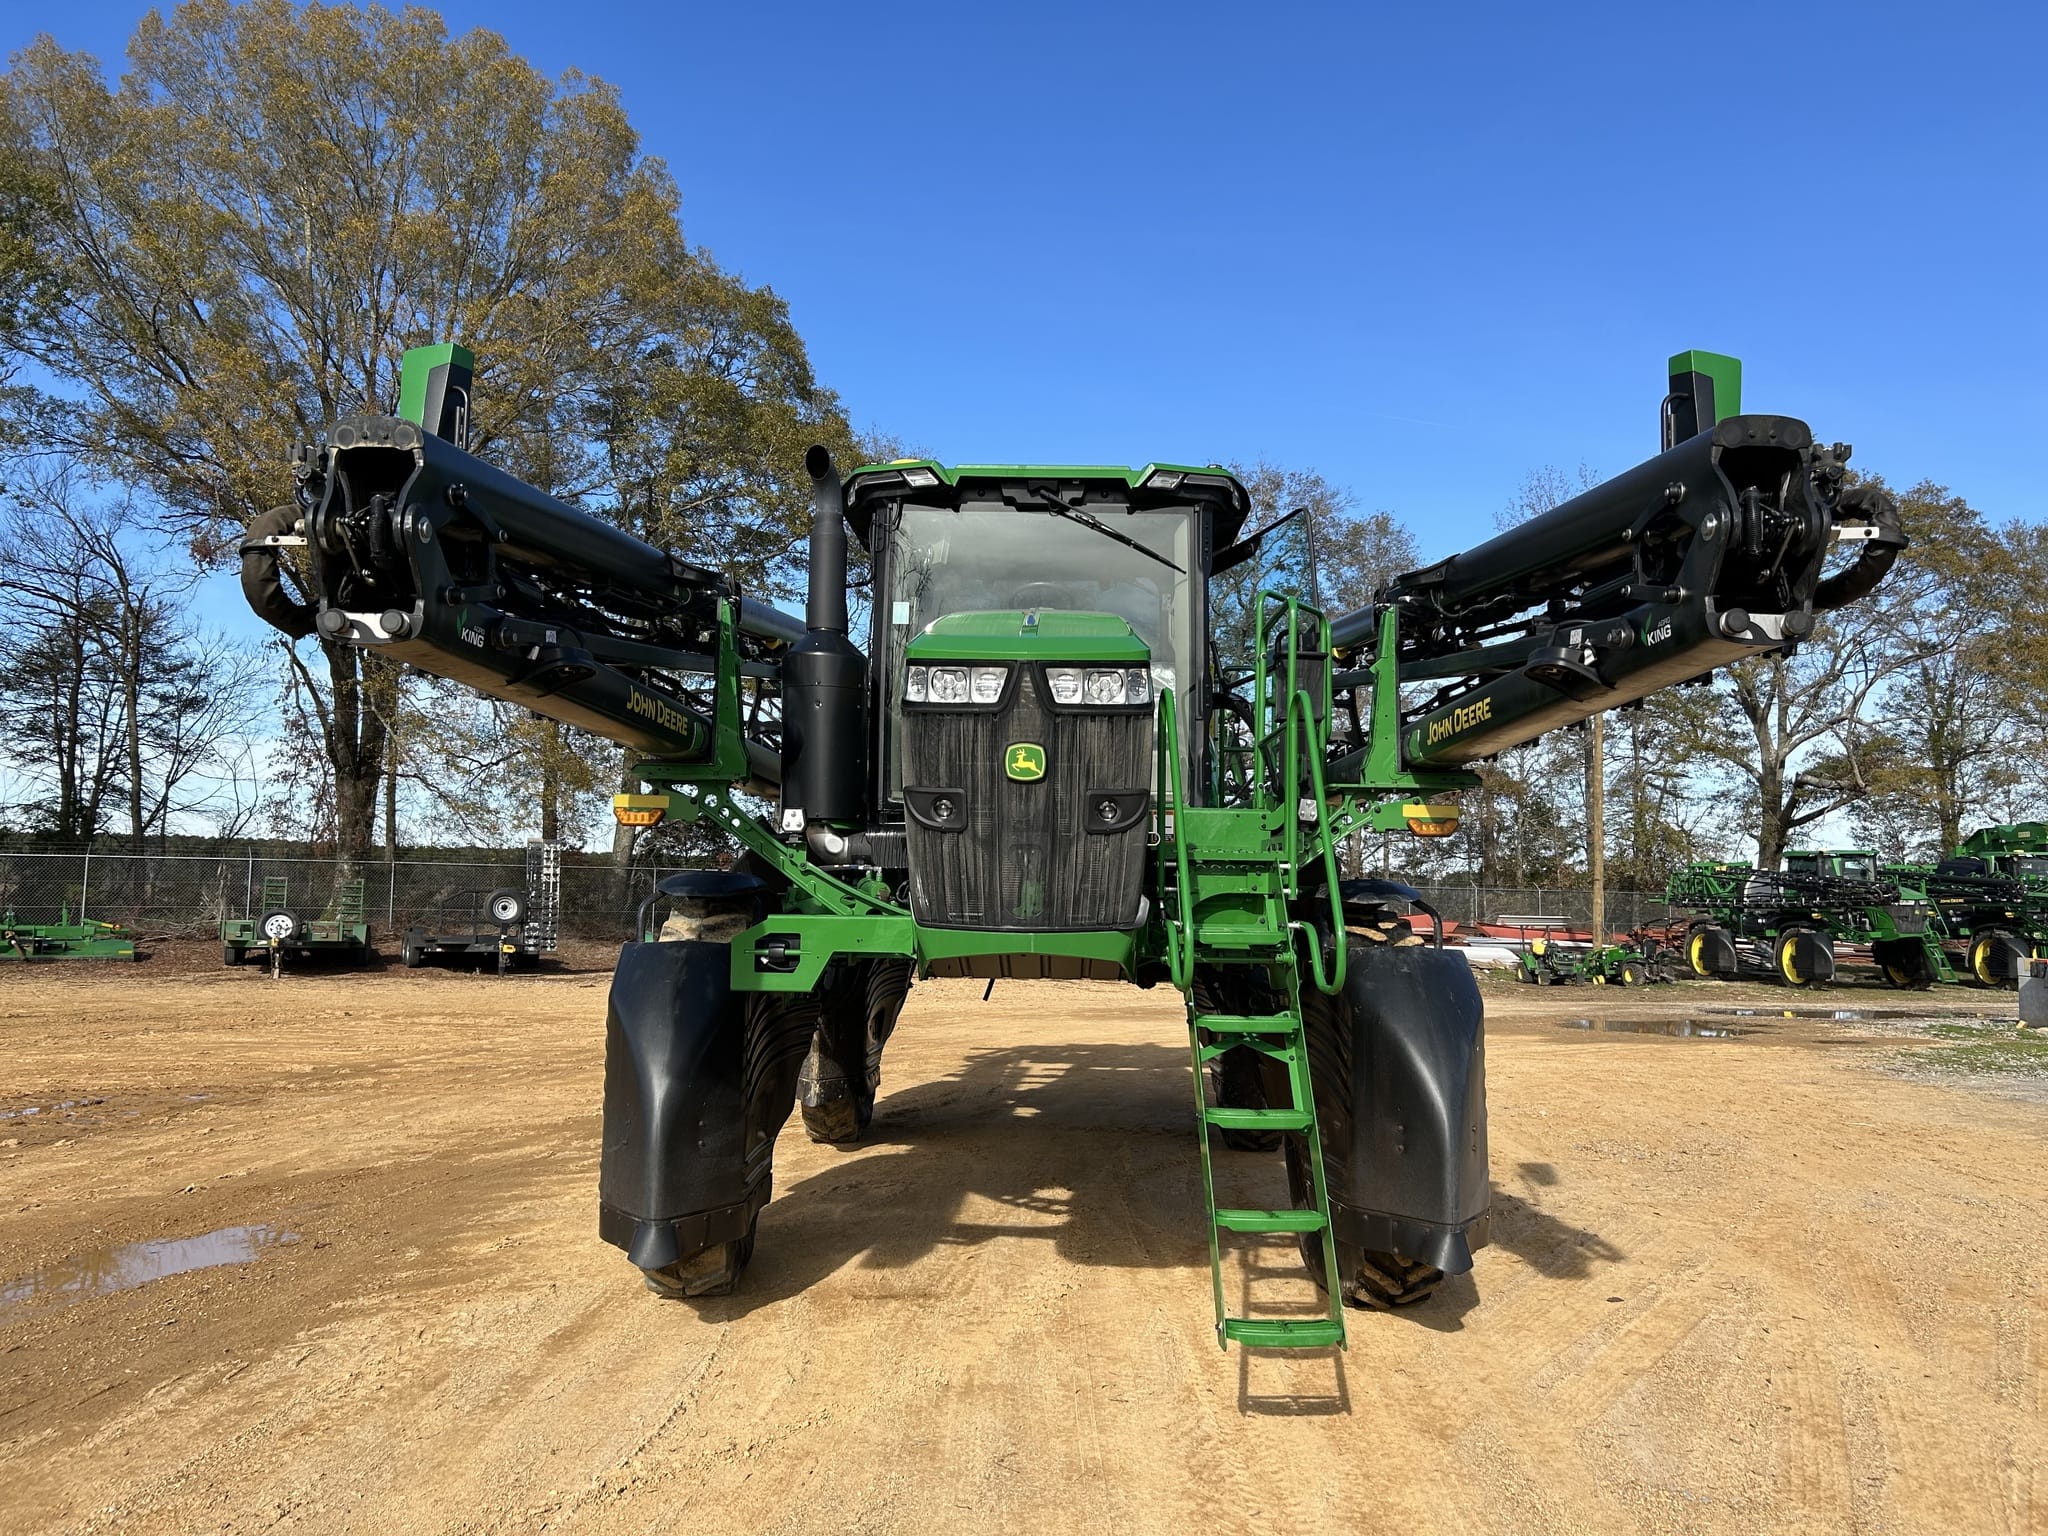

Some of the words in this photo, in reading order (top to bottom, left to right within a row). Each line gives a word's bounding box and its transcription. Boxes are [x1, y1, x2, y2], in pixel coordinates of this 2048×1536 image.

[461, 627, 485, 648] KING
[1647, 624, 1672, 646] KING
[626, 684, 656, 721] JOHN
[656, 699, 688, 736] DEERE
[1427, 715, 1453, 746] JOHN
[1454, 696, 1492, 733] DEERE
